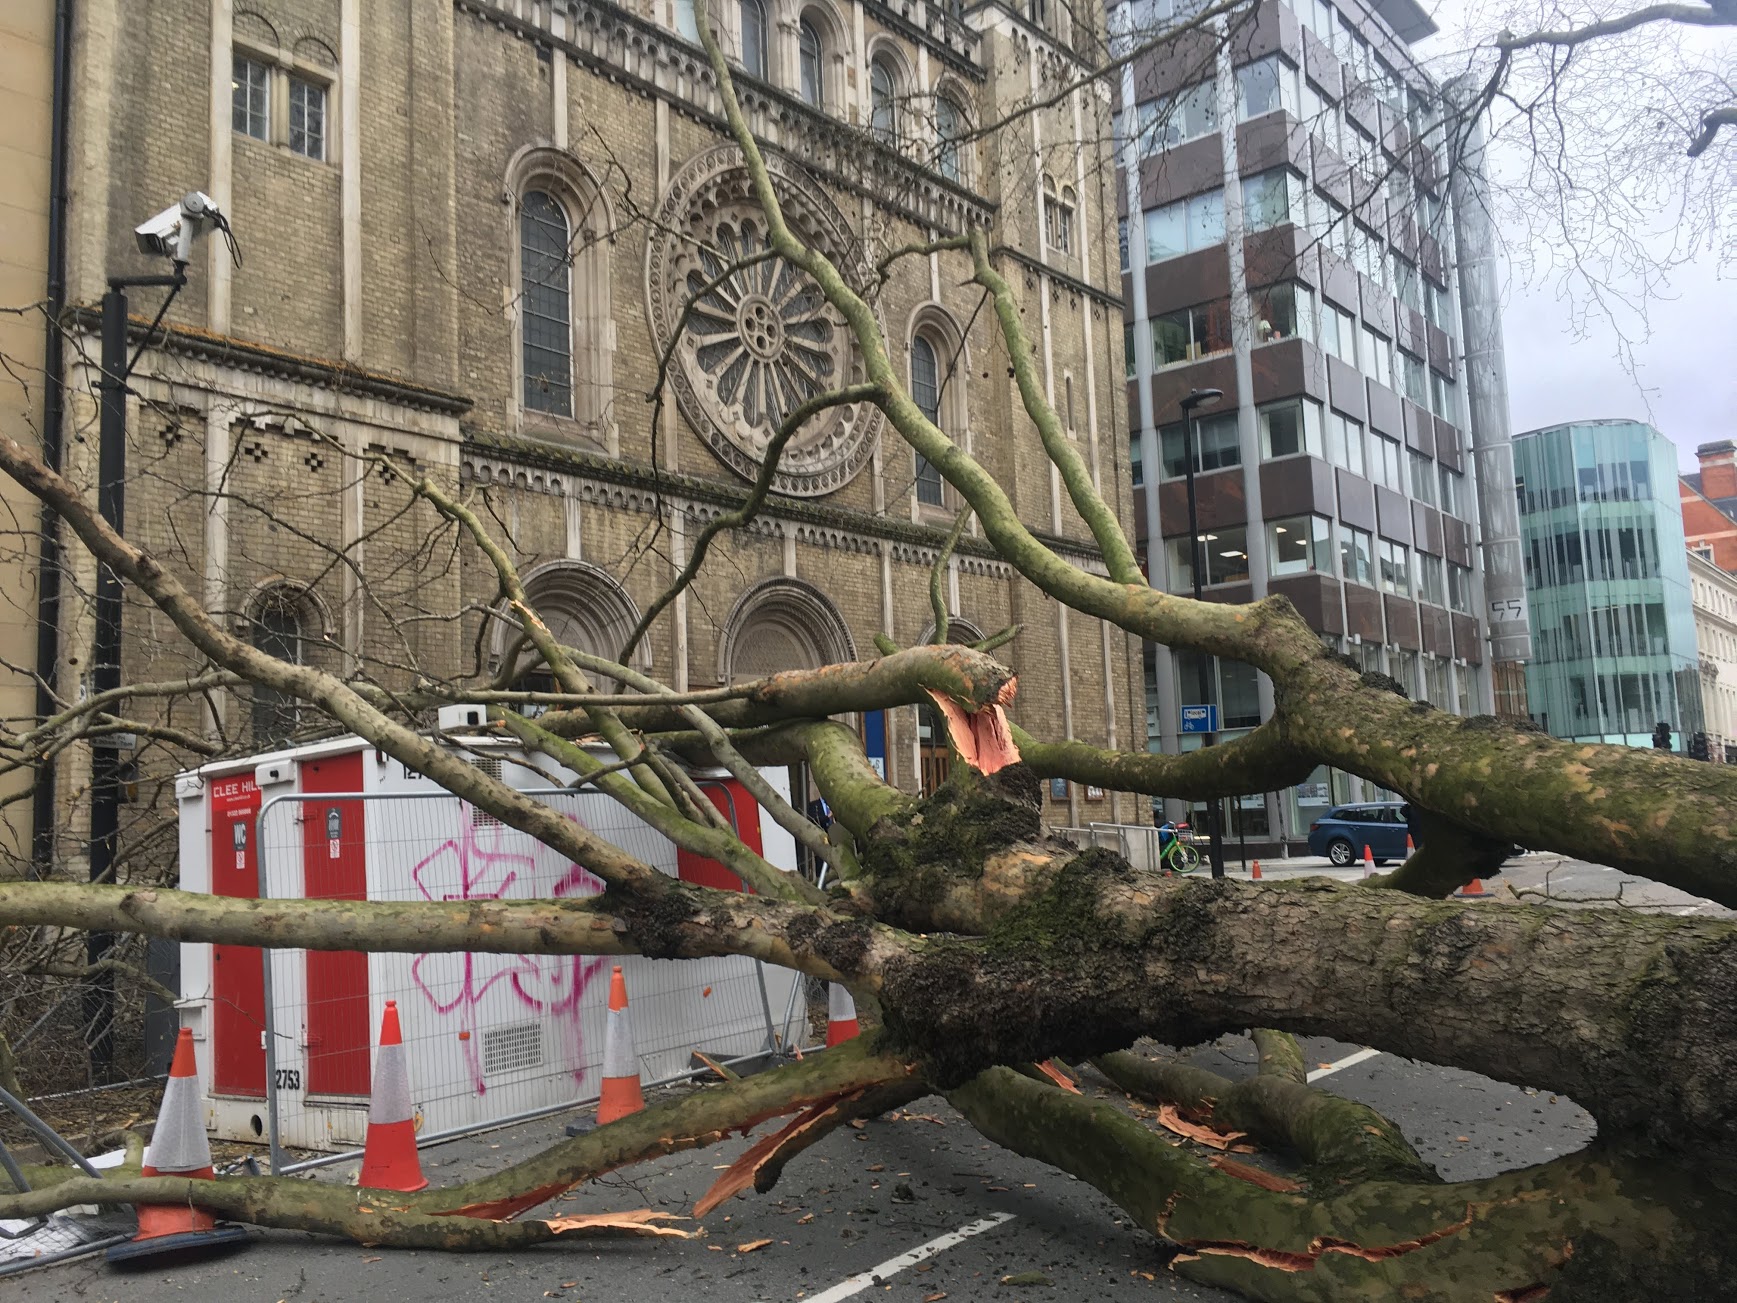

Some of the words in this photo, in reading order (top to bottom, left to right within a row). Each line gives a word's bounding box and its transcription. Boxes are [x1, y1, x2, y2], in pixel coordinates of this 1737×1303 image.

[1491, 599, 1521, 621] 55
[213, 783, 239, 798] CLEE
[233, 823, 246, 845] WC
[275, 1069, 300, 1090] 2753
